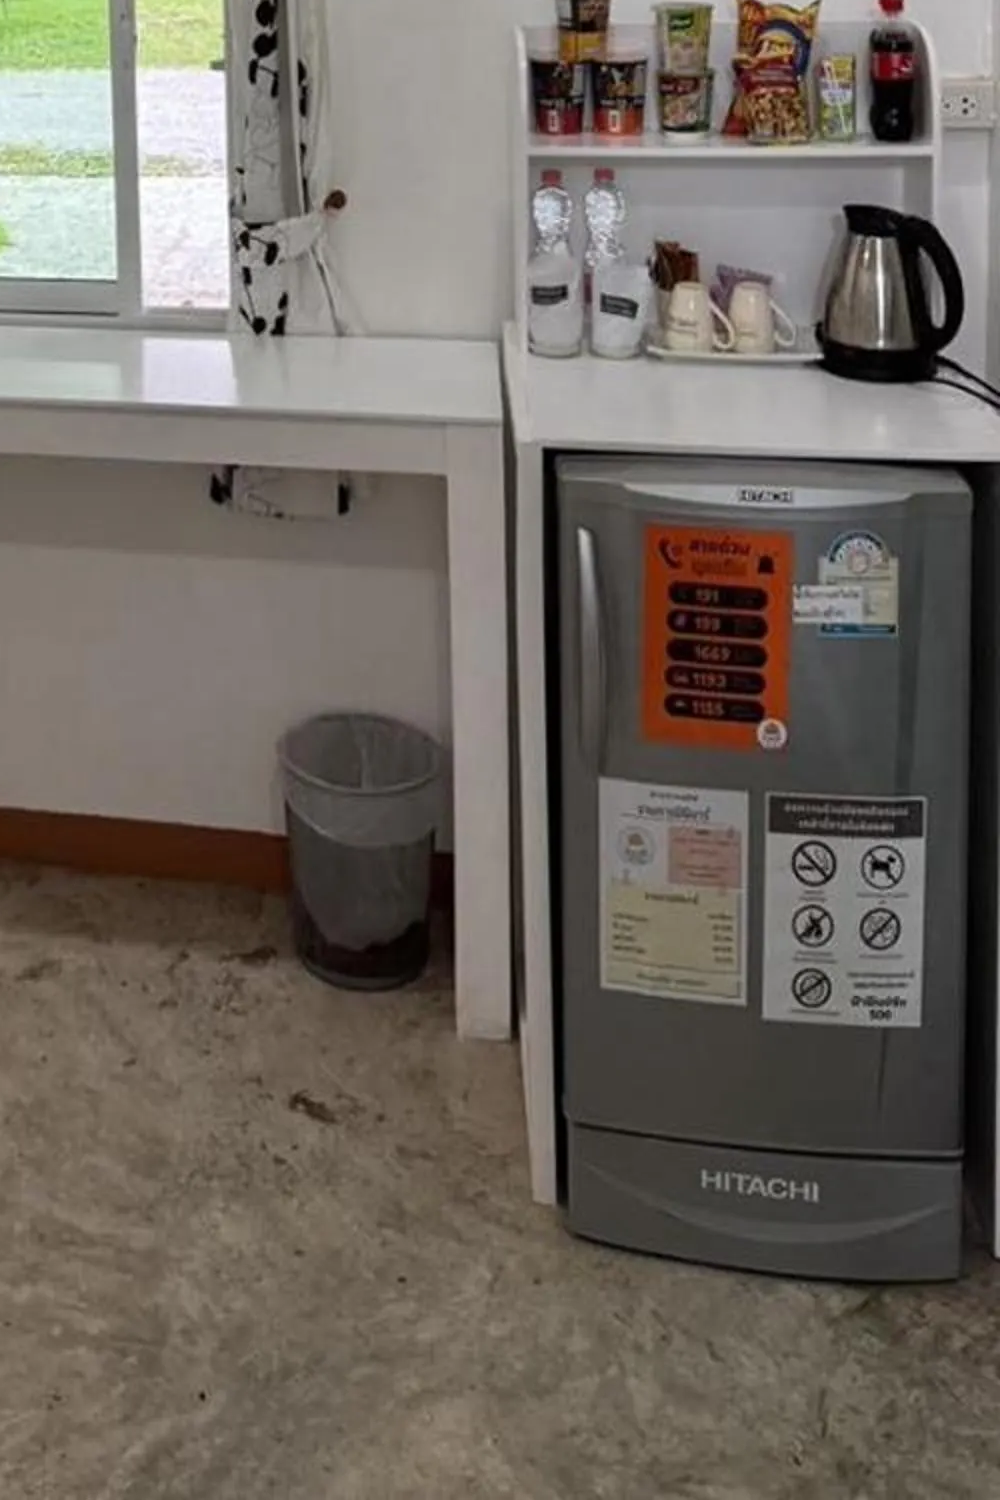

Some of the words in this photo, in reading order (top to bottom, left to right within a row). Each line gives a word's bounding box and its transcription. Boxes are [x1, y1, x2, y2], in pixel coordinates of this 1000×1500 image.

[696, 588, 719, 604] 191
[694, 643, 731, 661] 1669
[700, 1168, 820, 1203] HITACHI
